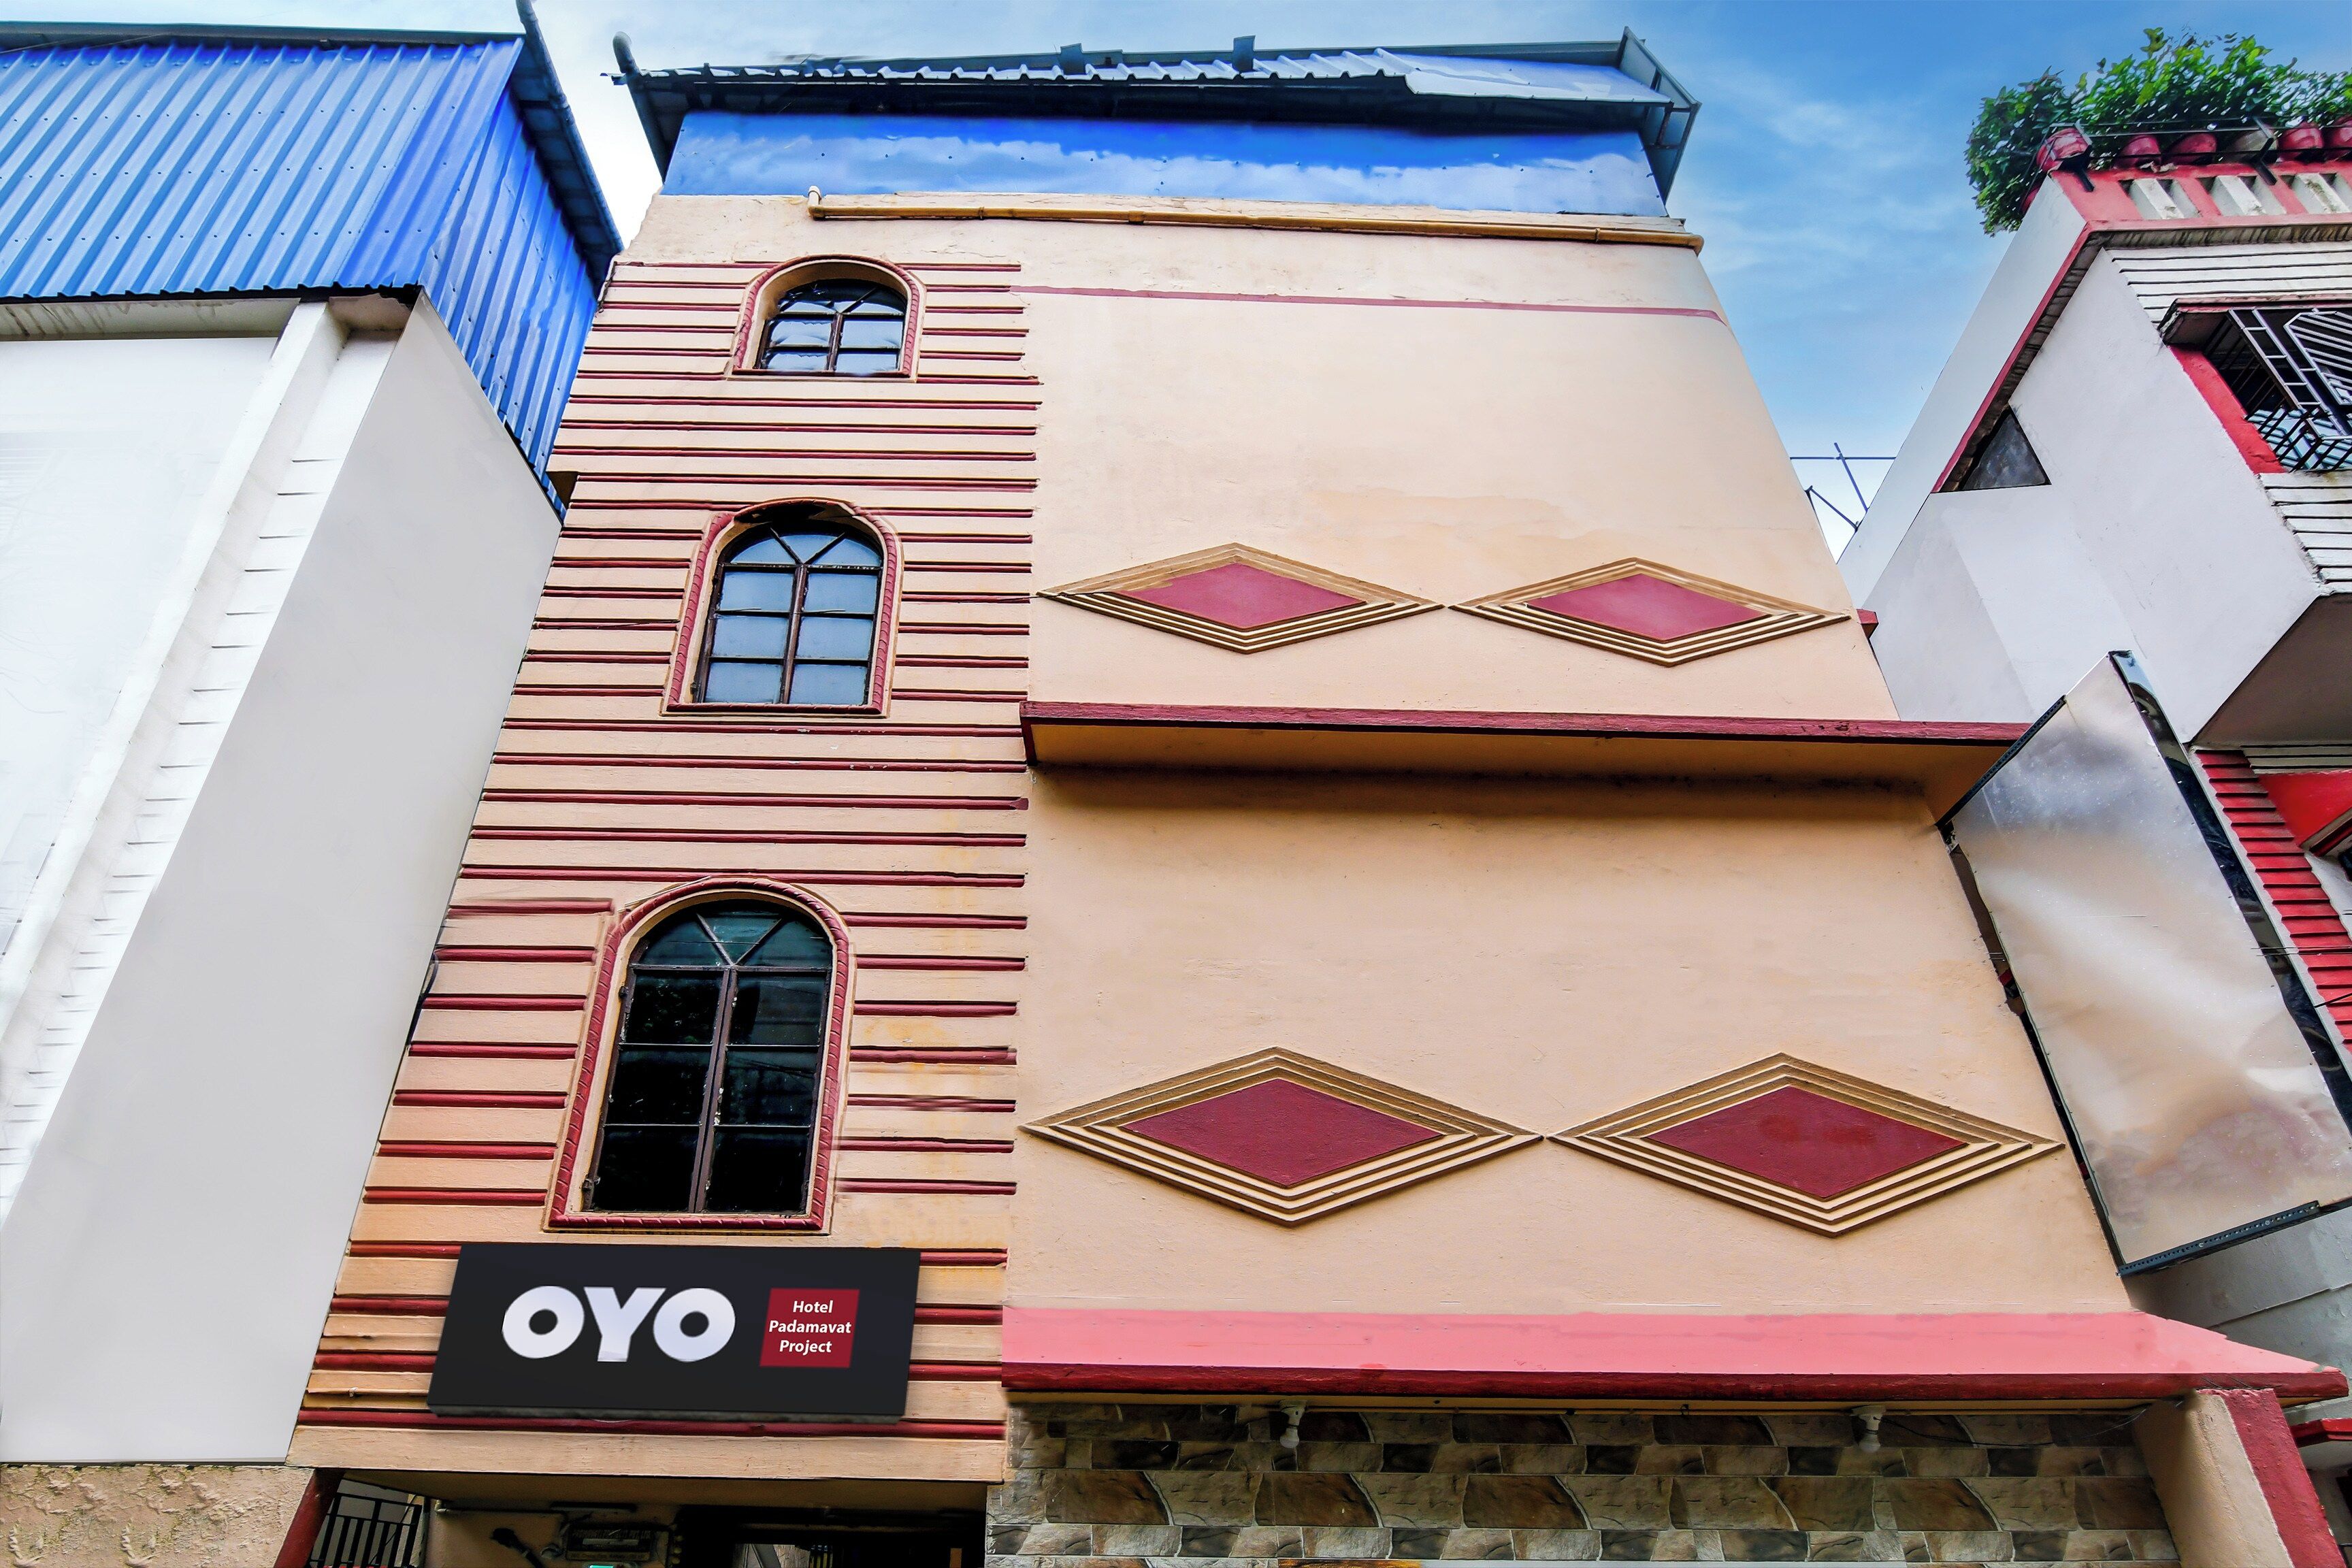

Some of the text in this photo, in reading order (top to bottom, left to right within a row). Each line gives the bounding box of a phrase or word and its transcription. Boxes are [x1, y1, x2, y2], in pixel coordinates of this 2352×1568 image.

[794, 1301, 834, 1313] Hotel
[502, 1286, 736, 1362] OYO
[768, 1320, 852, 1333] Padamavat
[779, 1339, 832, 1356] Project
